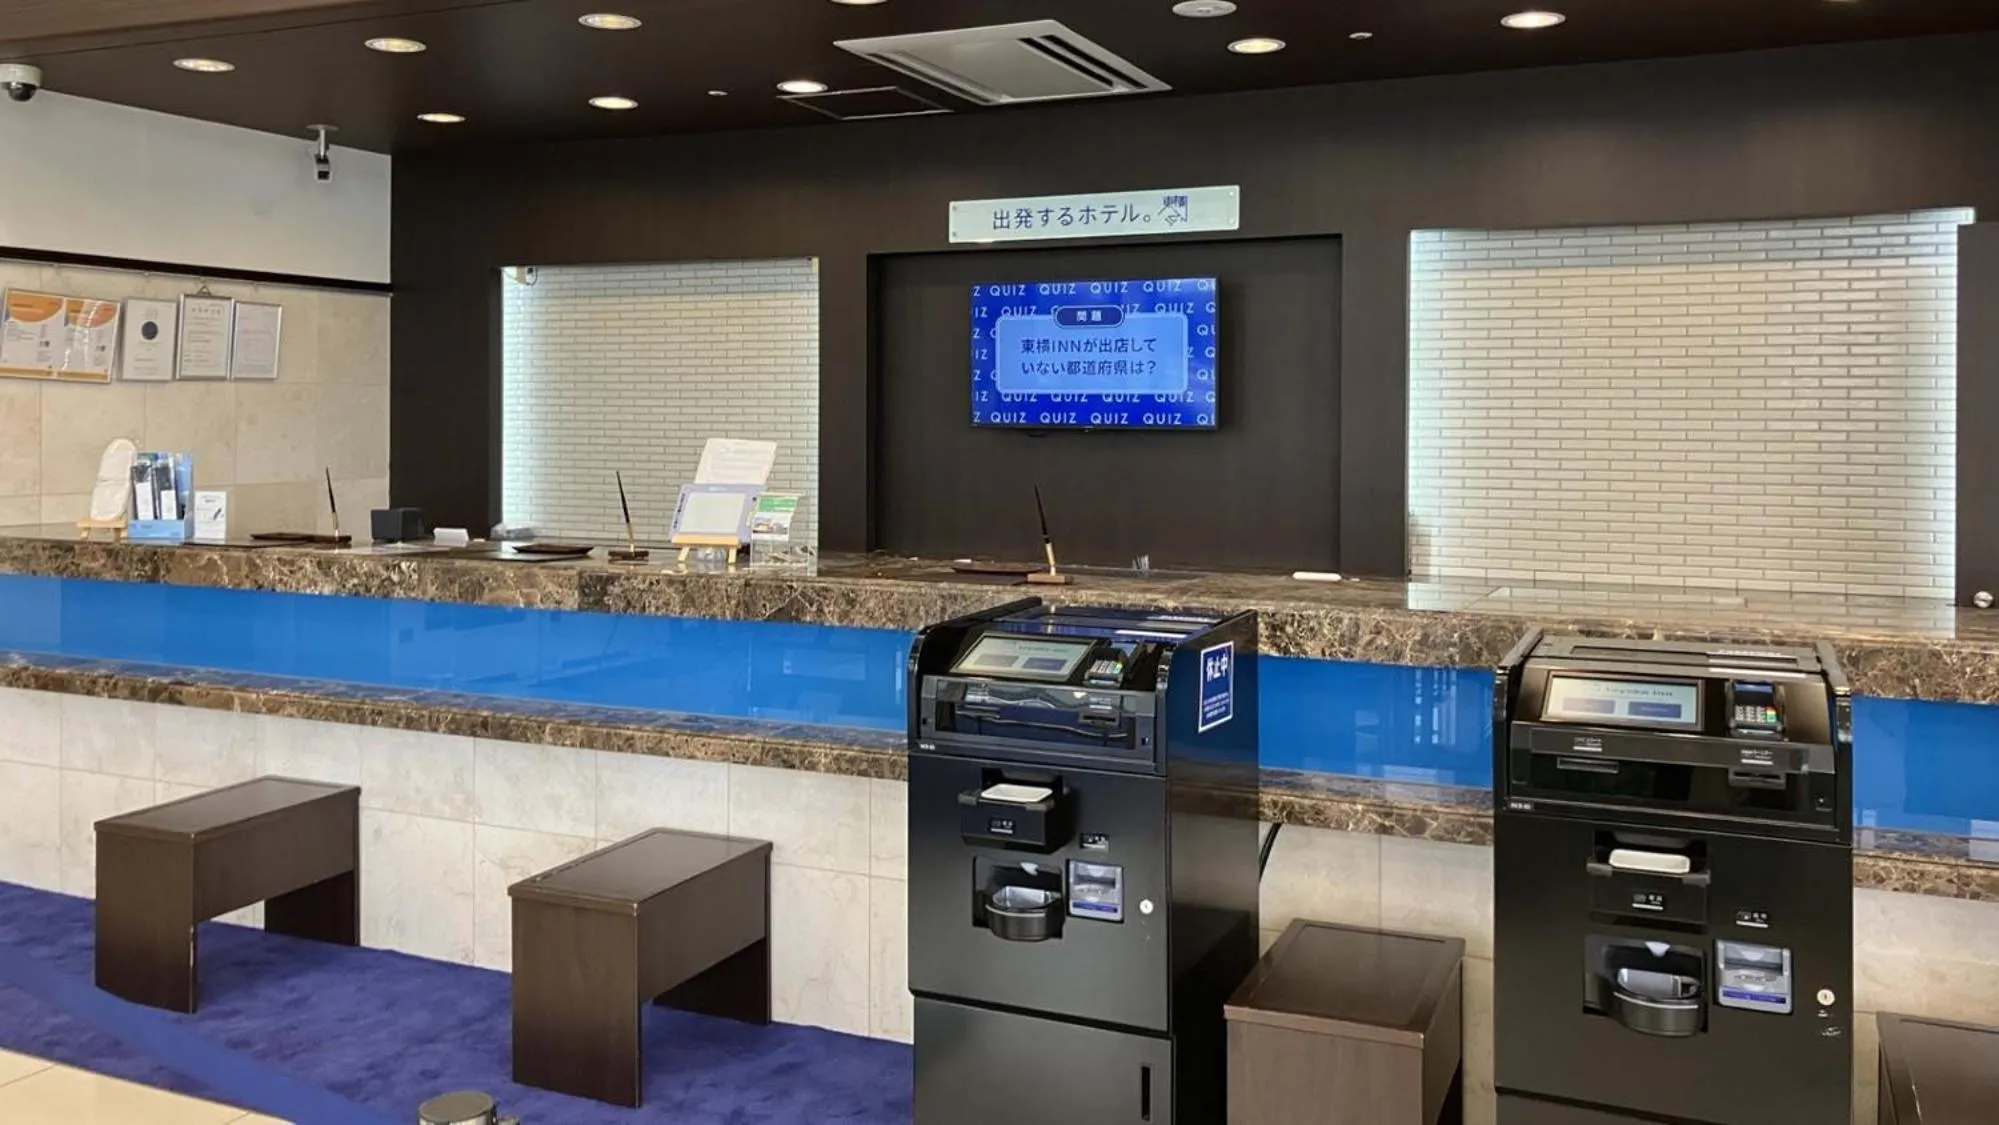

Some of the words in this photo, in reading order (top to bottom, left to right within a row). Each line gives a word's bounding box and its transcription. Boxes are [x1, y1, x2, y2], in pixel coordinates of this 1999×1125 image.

[992, 204, 1152, 230] 出発するホテル。
[990, 285, 1026, 297] QUIZ
[1040, 283, 1076, 295] QUIZ
[1090, 281, 1128, 294] QUIZ
[1143, 280, 1182, 293] QUIZ
[1021, 338, 1157, 354] 東横INNが出店して
[990, 411, 1027, 424] QUIZ
[1040, 411, 1077, 424] QUIZ
[1090, 413, 1128, 425] QUIZ
[1143, 413, 1182, 425] QUIZ
[1206, 653, 1228, 682] 休止中
